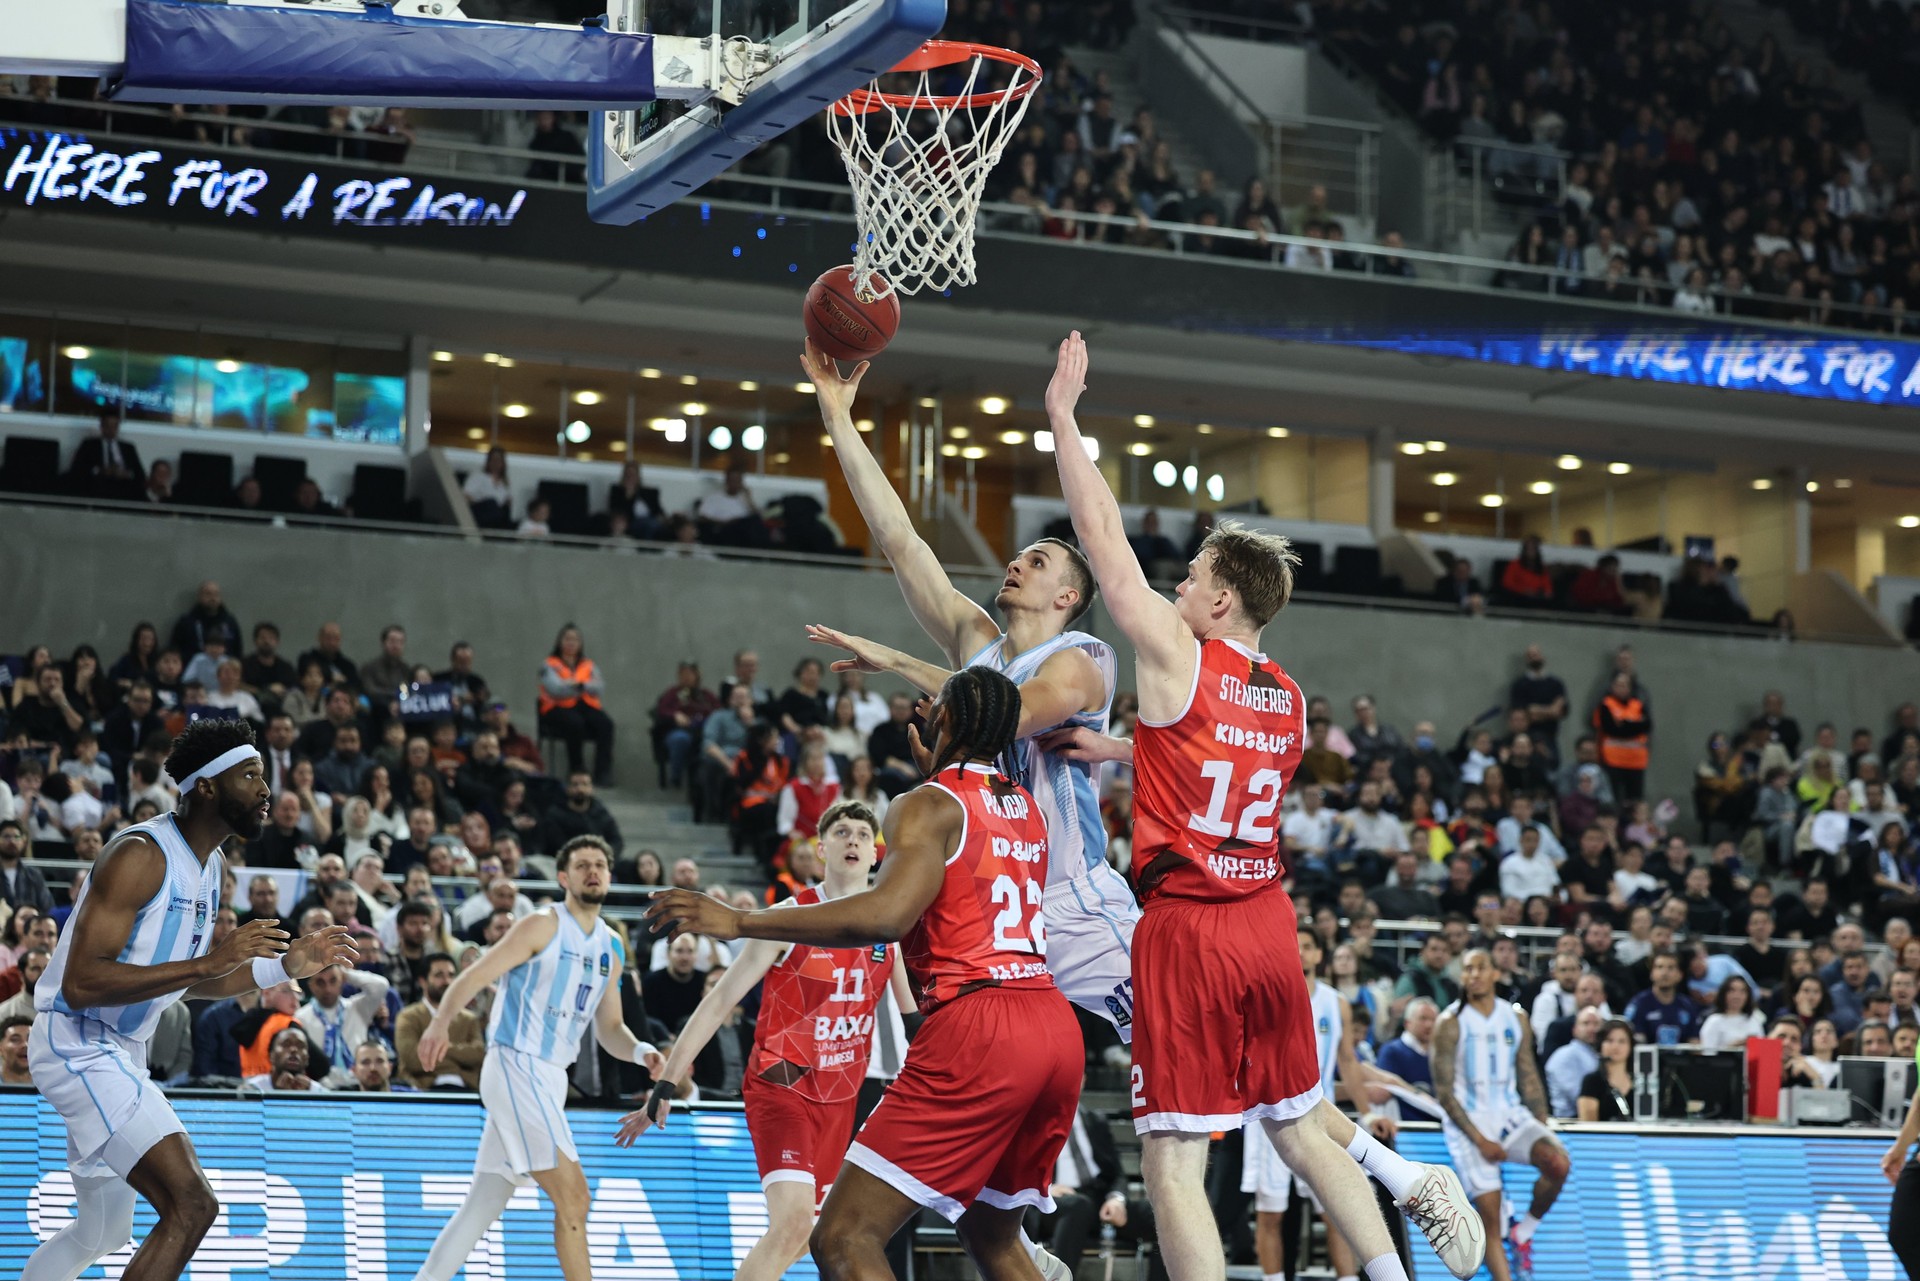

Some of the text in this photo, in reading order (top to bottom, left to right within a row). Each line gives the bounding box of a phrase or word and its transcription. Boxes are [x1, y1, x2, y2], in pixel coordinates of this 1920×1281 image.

[4, 134, 527, 226] HERE FOR A REASON
[817, 291, 873, 343] SPALDING
[1703, 332, 1818, 387] HERE
[1820, 344, 1896, 394] FOR
[1219, 673, 1293, 716] STENBERGS
[1215, 722, 1289, 755] KIDS&US
[1187, 760, 1282, 842] 12
[991, 874, 1047, 955] 22
[190, 934, 202, 960] 7
[575, 983, 593, 1011] 10
[829, 967, 866, 1002] 11
[814, 1013, 874, 1041] BAXI
[1131, 1064, 1147, 1108] 2
